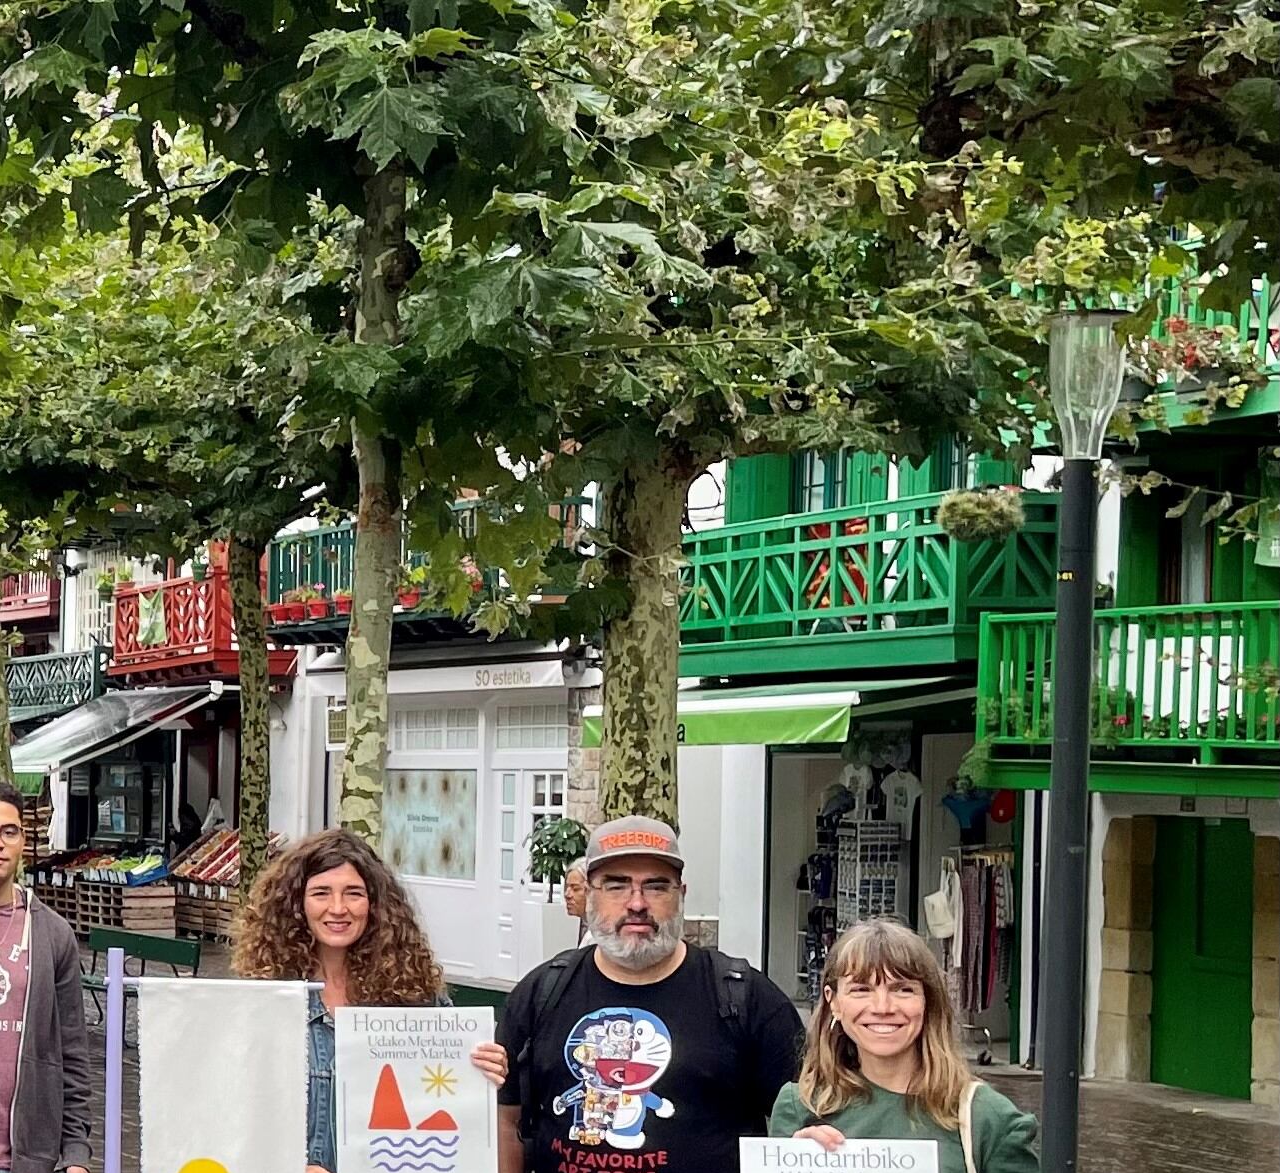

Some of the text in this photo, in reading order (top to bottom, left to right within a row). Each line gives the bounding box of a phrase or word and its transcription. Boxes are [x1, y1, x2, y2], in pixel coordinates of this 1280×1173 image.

[475, 669, 531, 687] SO estetika
[599, 831, 671, 851] TREEFORT
[353, 1013, 477, 1033] Hondarribiko
[367, 1036, 463, 1048] Udako Merkatua
[369, 1048, 461, 1060] Summer Market
[551, 1138, 668, 1169] MY FAVORITE
[763, 1145, 915, 1170] Hondarribiko
